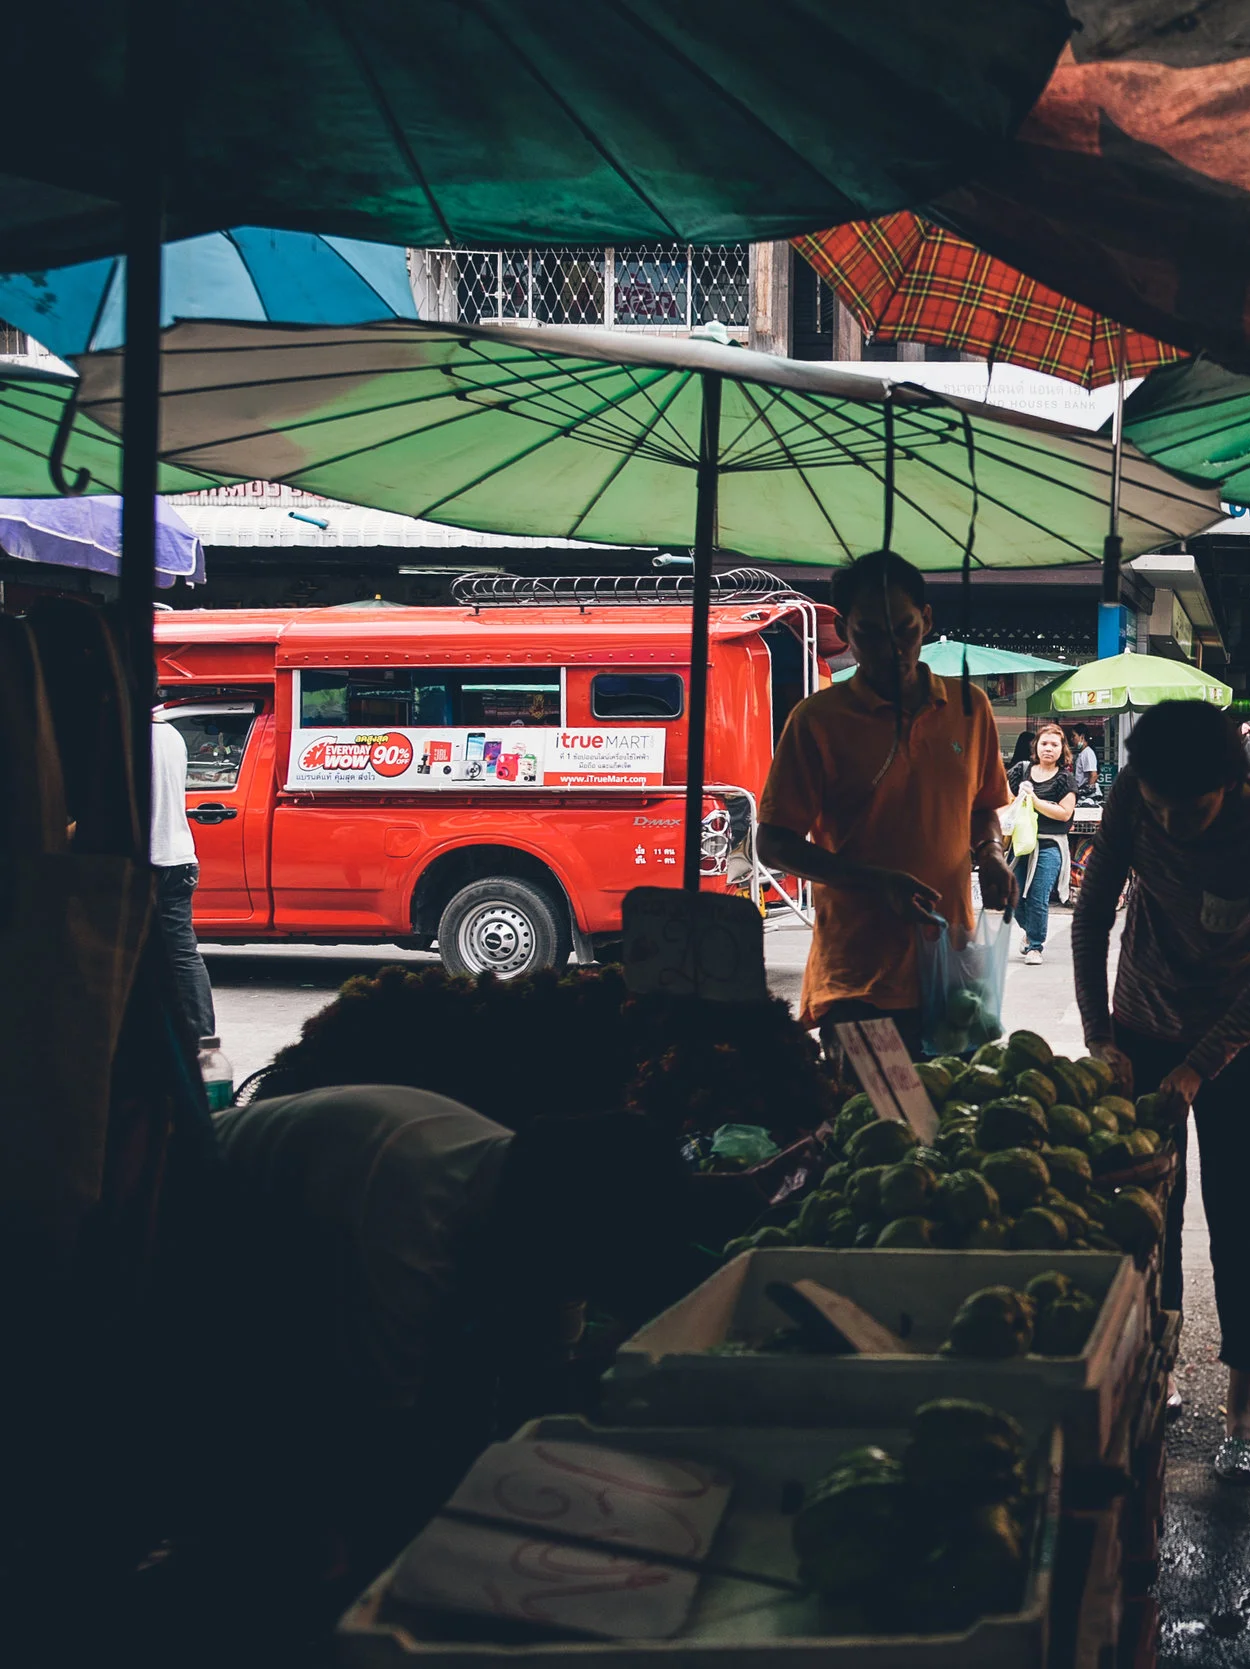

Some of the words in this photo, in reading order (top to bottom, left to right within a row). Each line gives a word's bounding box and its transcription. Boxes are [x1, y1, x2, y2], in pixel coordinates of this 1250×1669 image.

[1010, 400, 1058, 409] HOUSES
[1064, 401, 1096, 410] BANK
[1073, 691, 1112, 705] M2F
[325, 745, 372, 754] EVERYDAY
[433, 748, 449, 761] JBL
[324, 755, 370, 769] WOW
[560, 775, 647, 783] www.iTrueMart.com
[635, 844, 646, 855] นั่ง
[664, 857, 676, 865] คน
